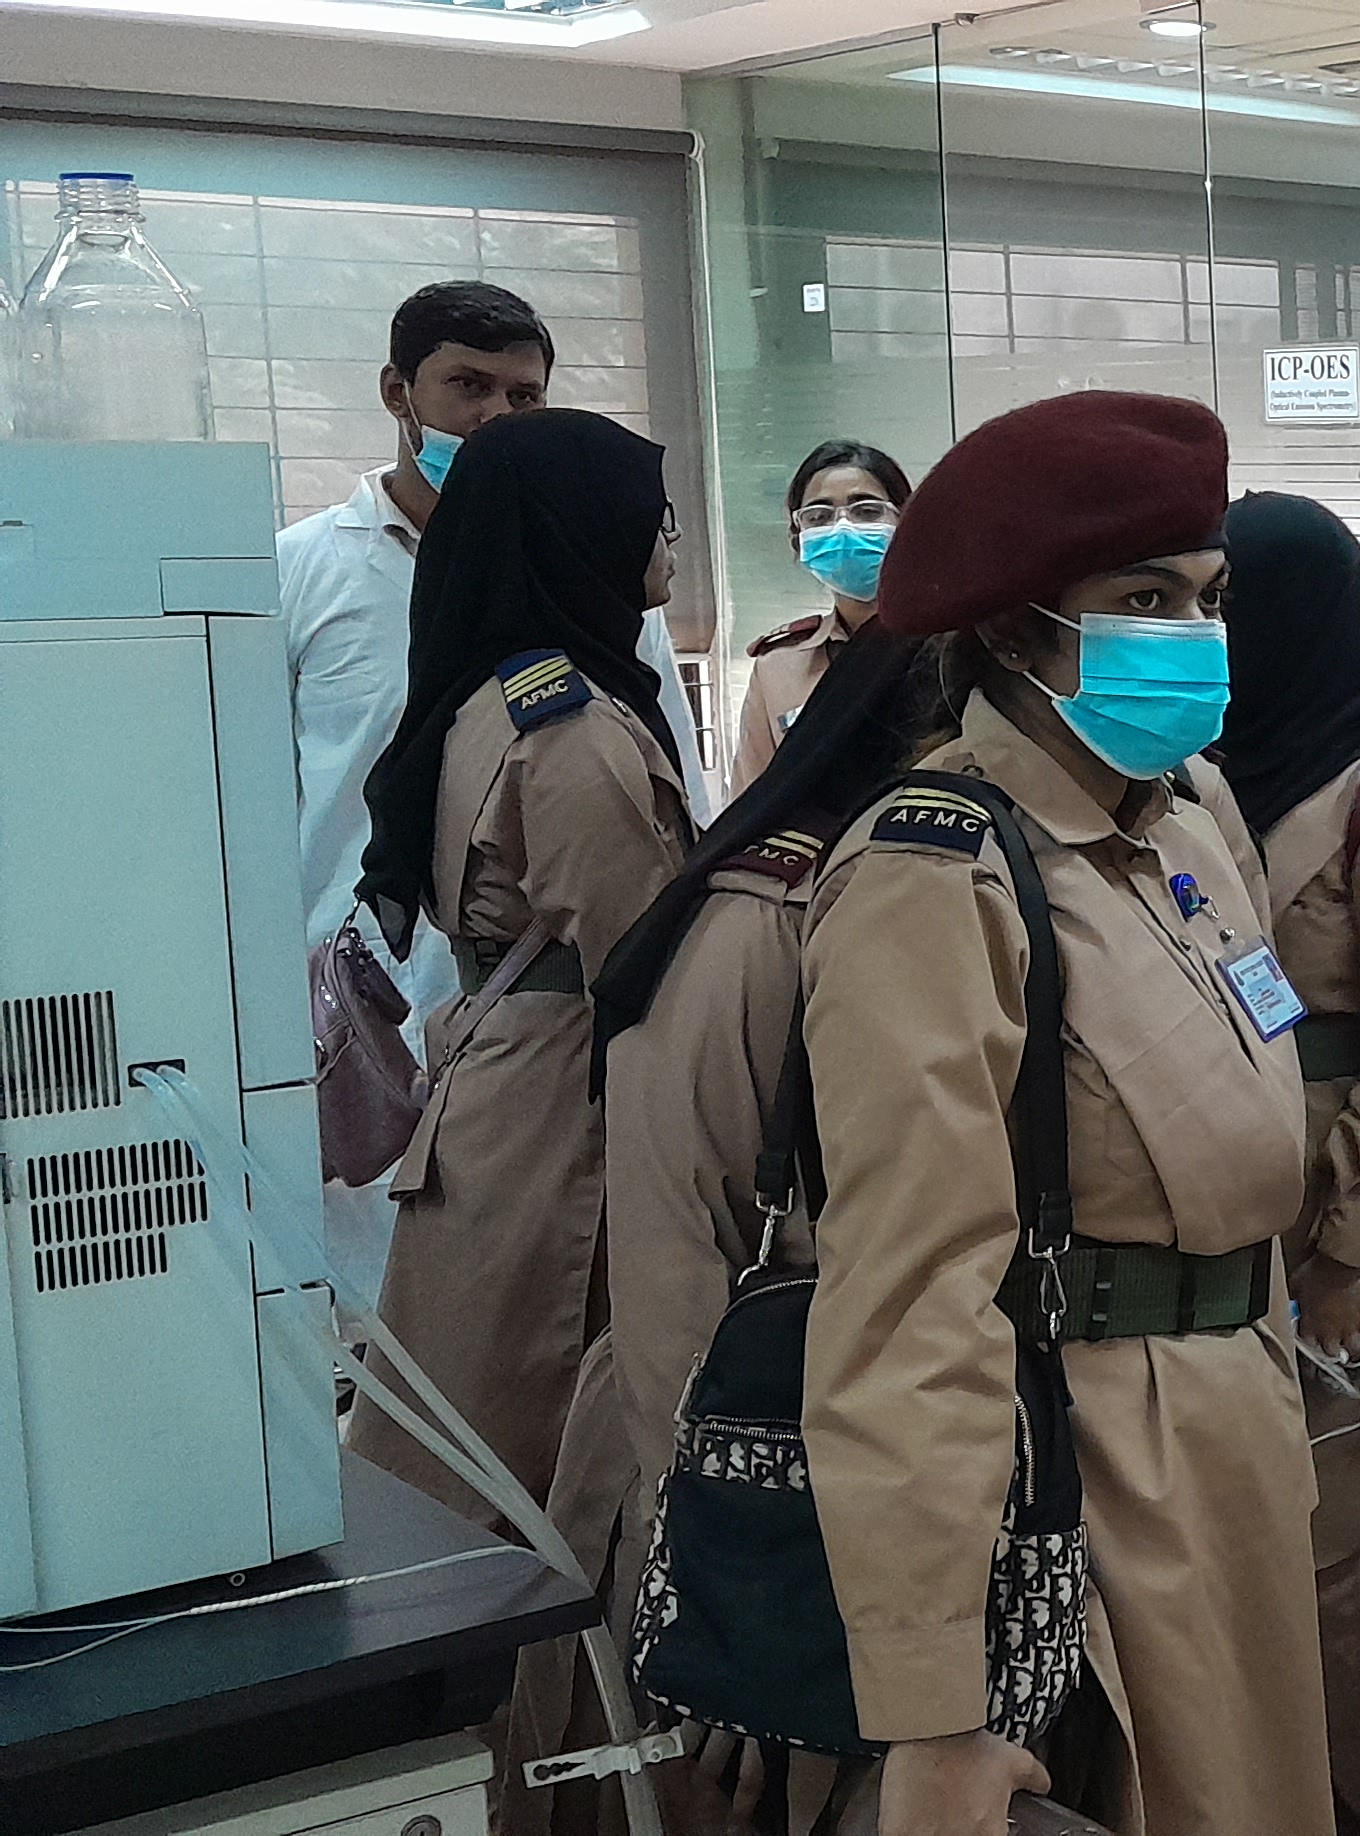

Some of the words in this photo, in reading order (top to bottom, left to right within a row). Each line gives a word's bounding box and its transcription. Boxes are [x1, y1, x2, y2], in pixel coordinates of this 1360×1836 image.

[1270, 353, 1351, 381] ICP-OES
[521, 679, 570, 711] AFMC
[889, 807, 981, 833] AFMC
